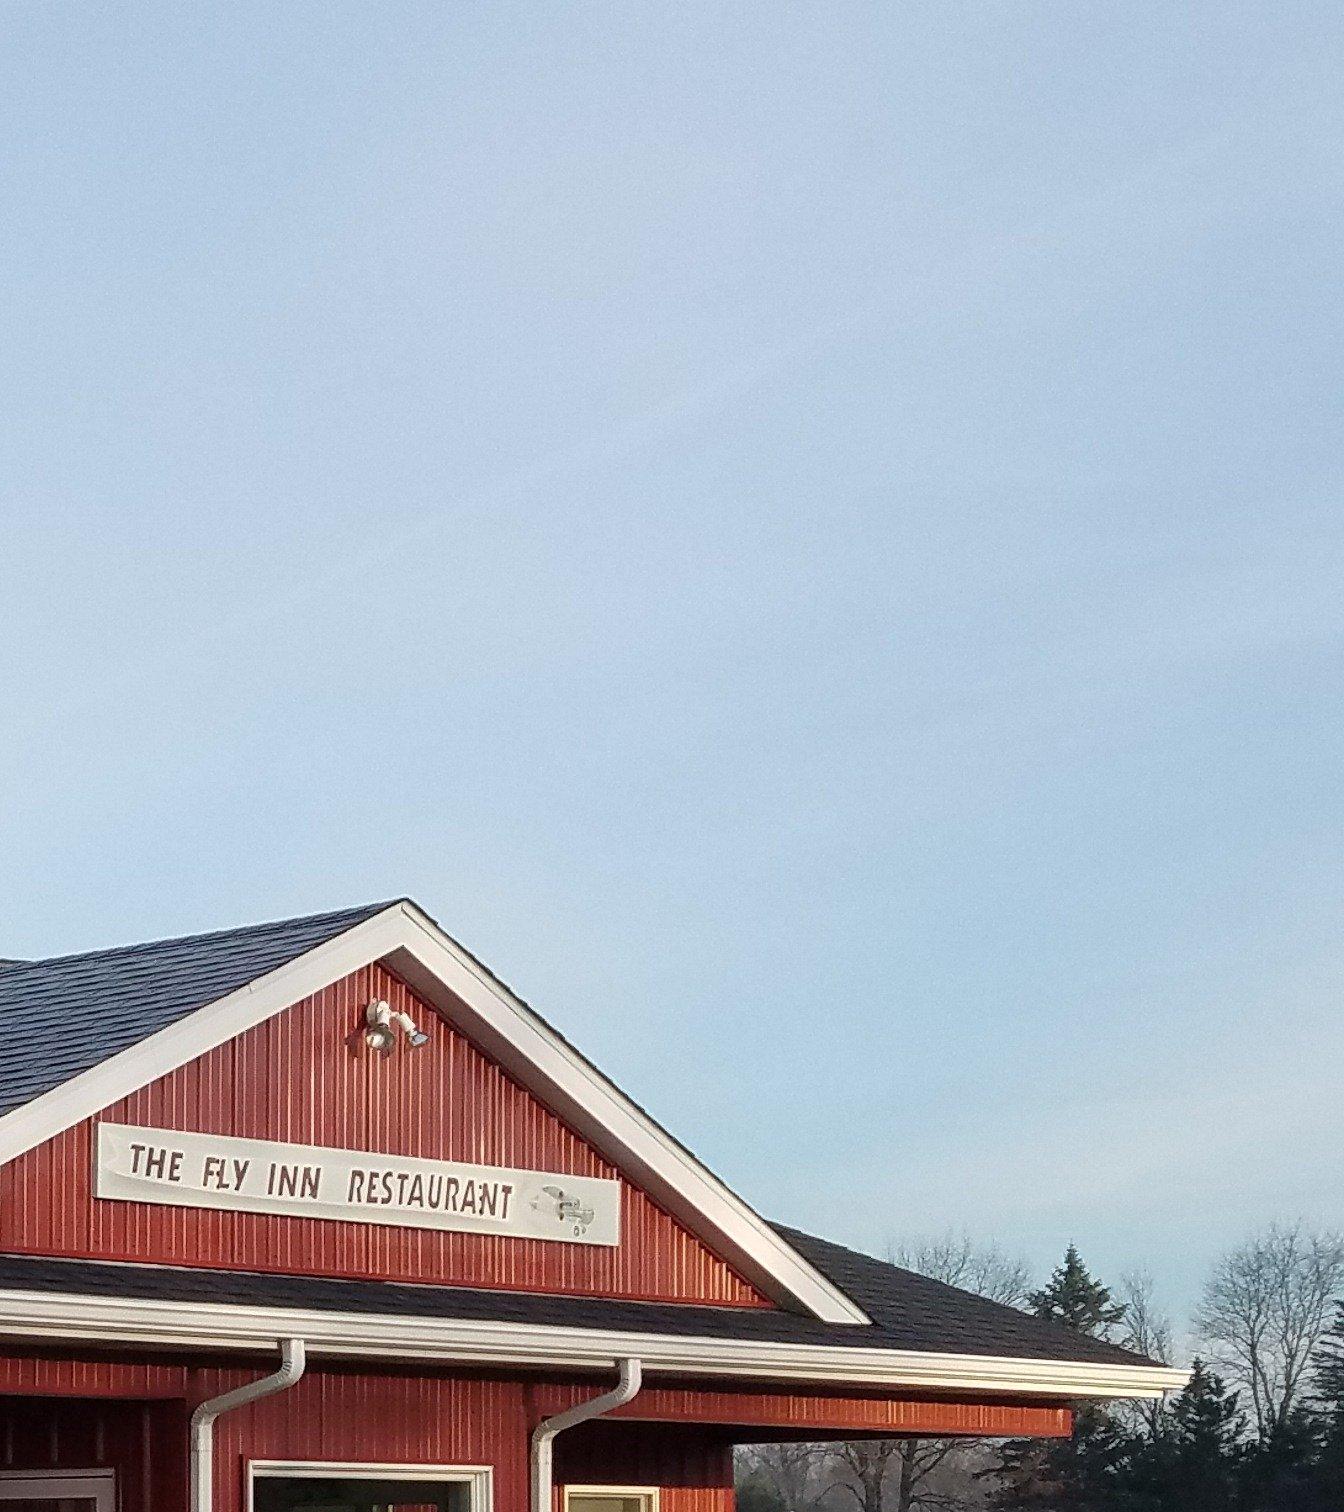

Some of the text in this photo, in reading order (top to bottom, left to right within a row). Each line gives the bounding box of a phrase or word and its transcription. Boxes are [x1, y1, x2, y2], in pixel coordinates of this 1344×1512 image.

[129, 1143, 514, 1220] THE FLY INN RESTAURANT
